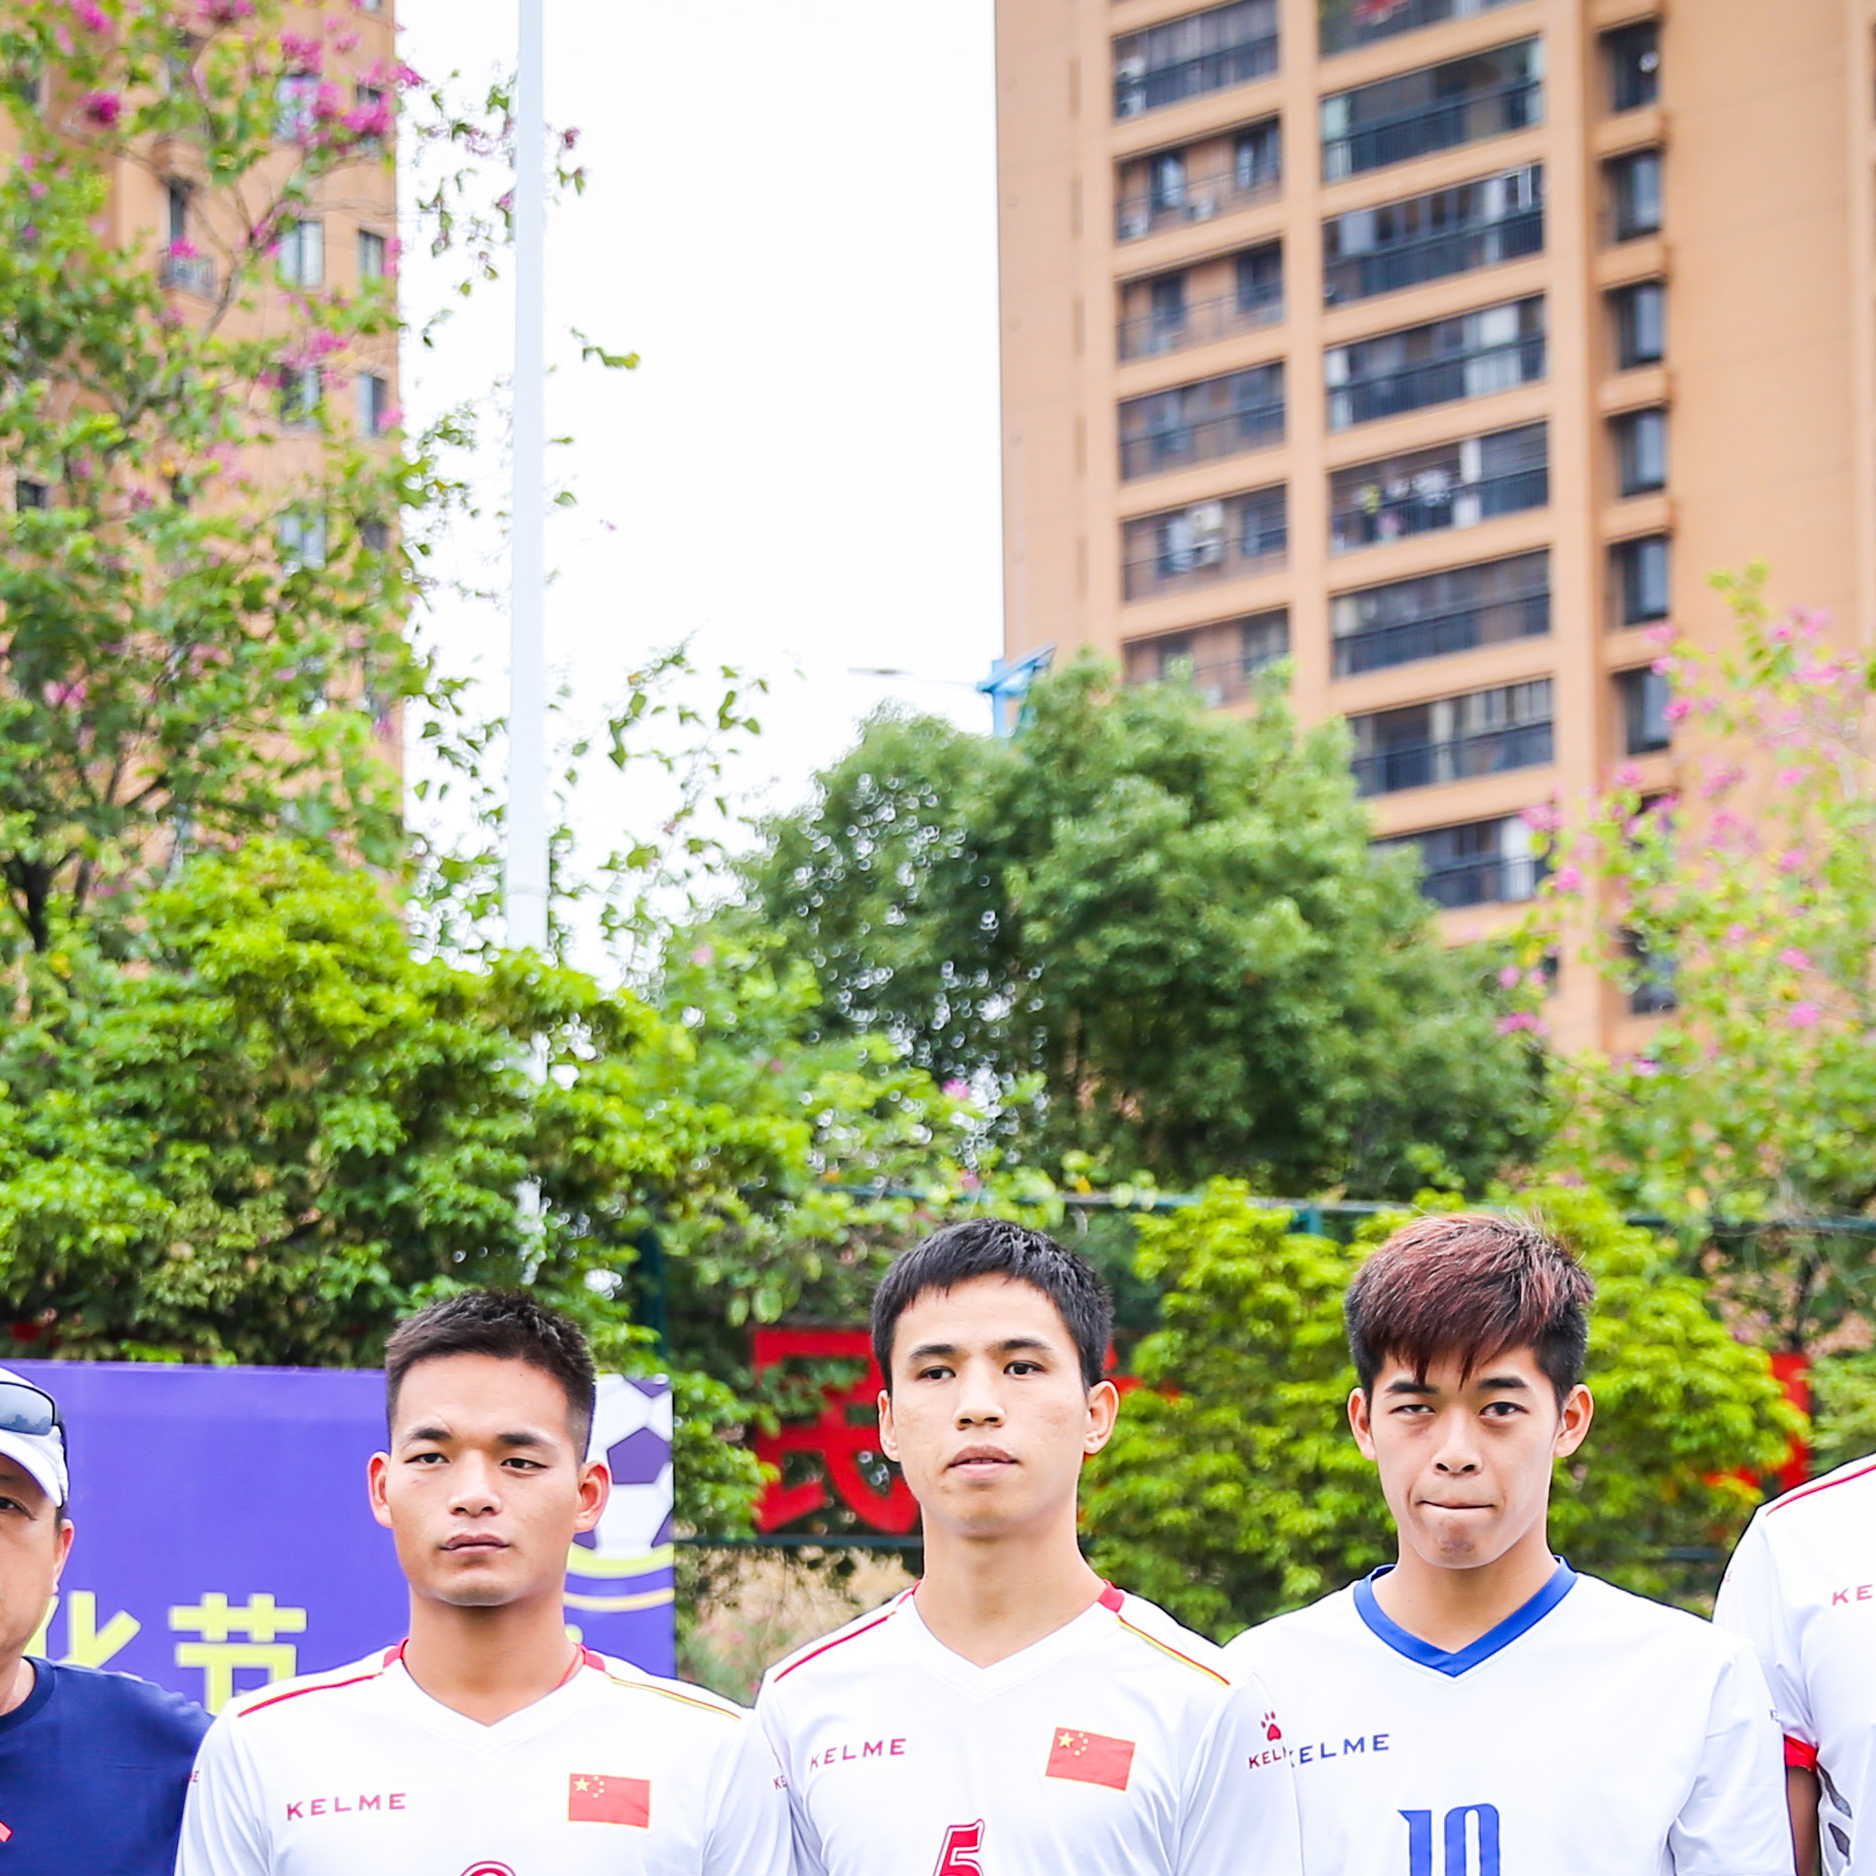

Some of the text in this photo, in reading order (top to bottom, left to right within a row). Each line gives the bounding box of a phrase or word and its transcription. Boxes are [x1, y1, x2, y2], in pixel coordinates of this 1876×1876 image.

[809, 1738, 907, 1773] KELME
[1248, 1746, 1288, 1769] KEL
[286, 1793, 408, 1822] KELME
